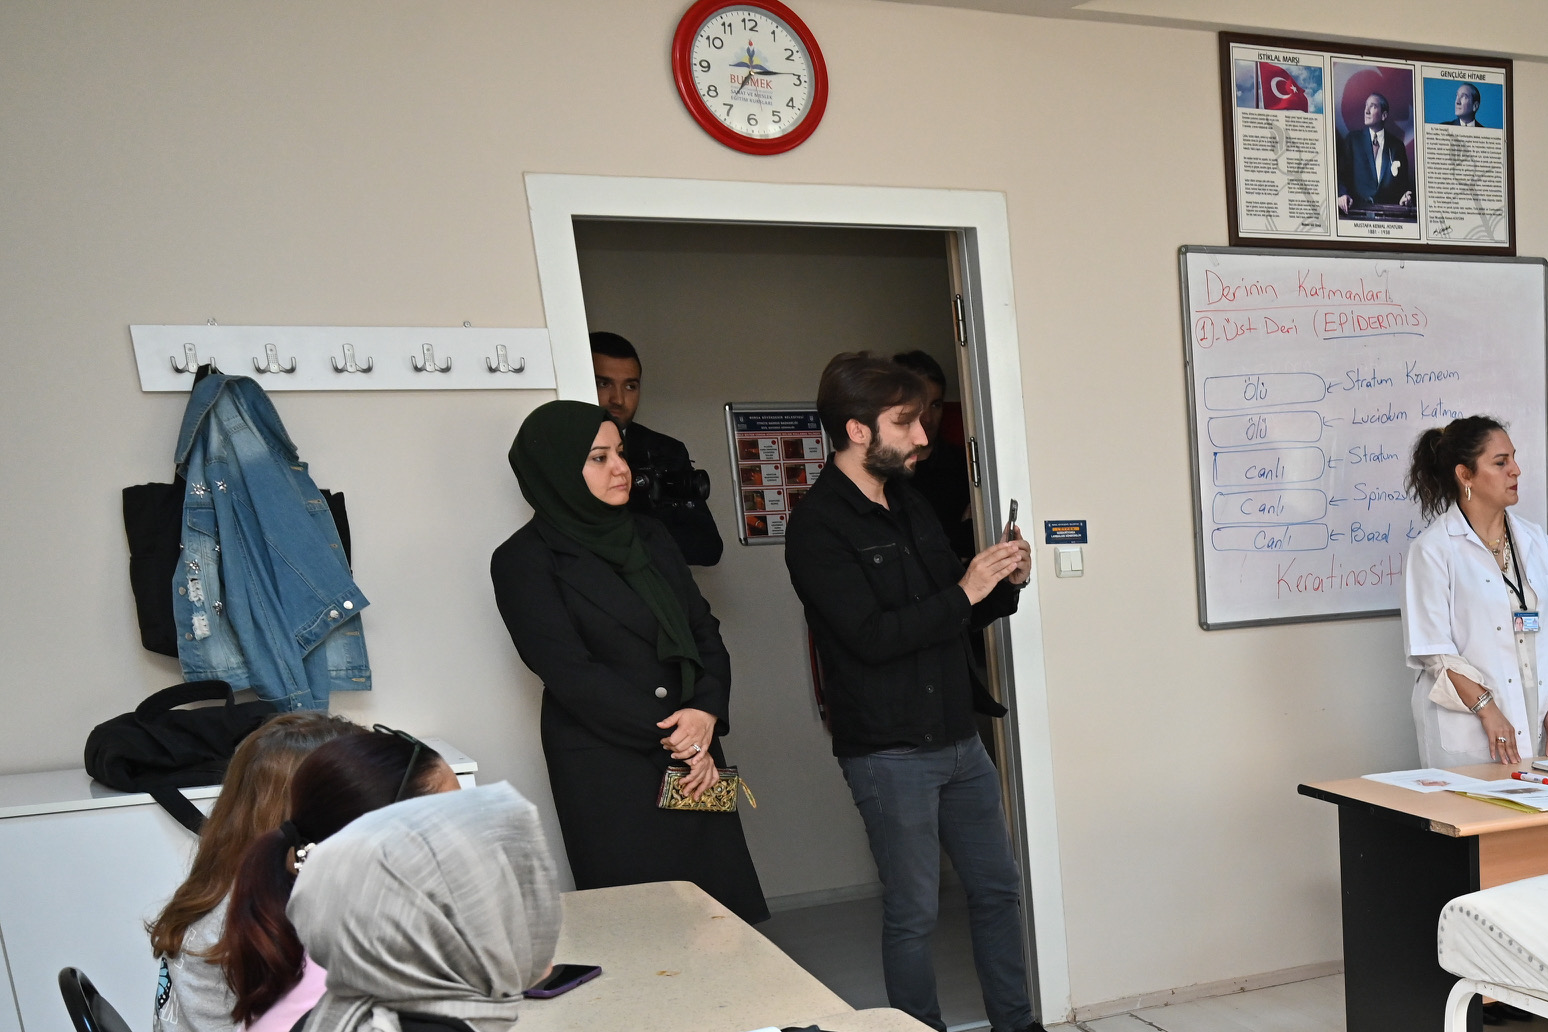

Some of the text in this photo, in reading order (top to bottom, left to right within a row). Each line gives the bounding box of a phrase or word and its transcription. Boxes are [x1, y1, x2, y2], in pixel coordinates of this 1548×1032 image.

[721, 21, 733, 35] 11
[741, 17, 759, 32] 12
[705, 35, 724, 49] 10
[770, 30, 776, 42] 1
[784, 48, 795, 61] 2
[699, 59, 711, 72] 9
[793, 73, 802, 86] 3
[1467, 72, 1486, 81] HİTABE
[707, 84, 719, 98] 8
[722, 103, 734, 117] 7
[786, 97, 796, 109] 4
[747, 113, 758, 126] 6
[771, 110, 782, 123] 5
[1205, 269, 1390, 305] Derinin Katmanları
[1264, 316, 1298, 335] Deri
[1343, 367, 1393, 391] Stratum
[1244, 376, 1267, 401] Ölü
[1352, 402, 1407, 425] Lucidum
[1246, 416, 1267, 440] Ölü
[1349, 444, 1399, 465] Stratum
